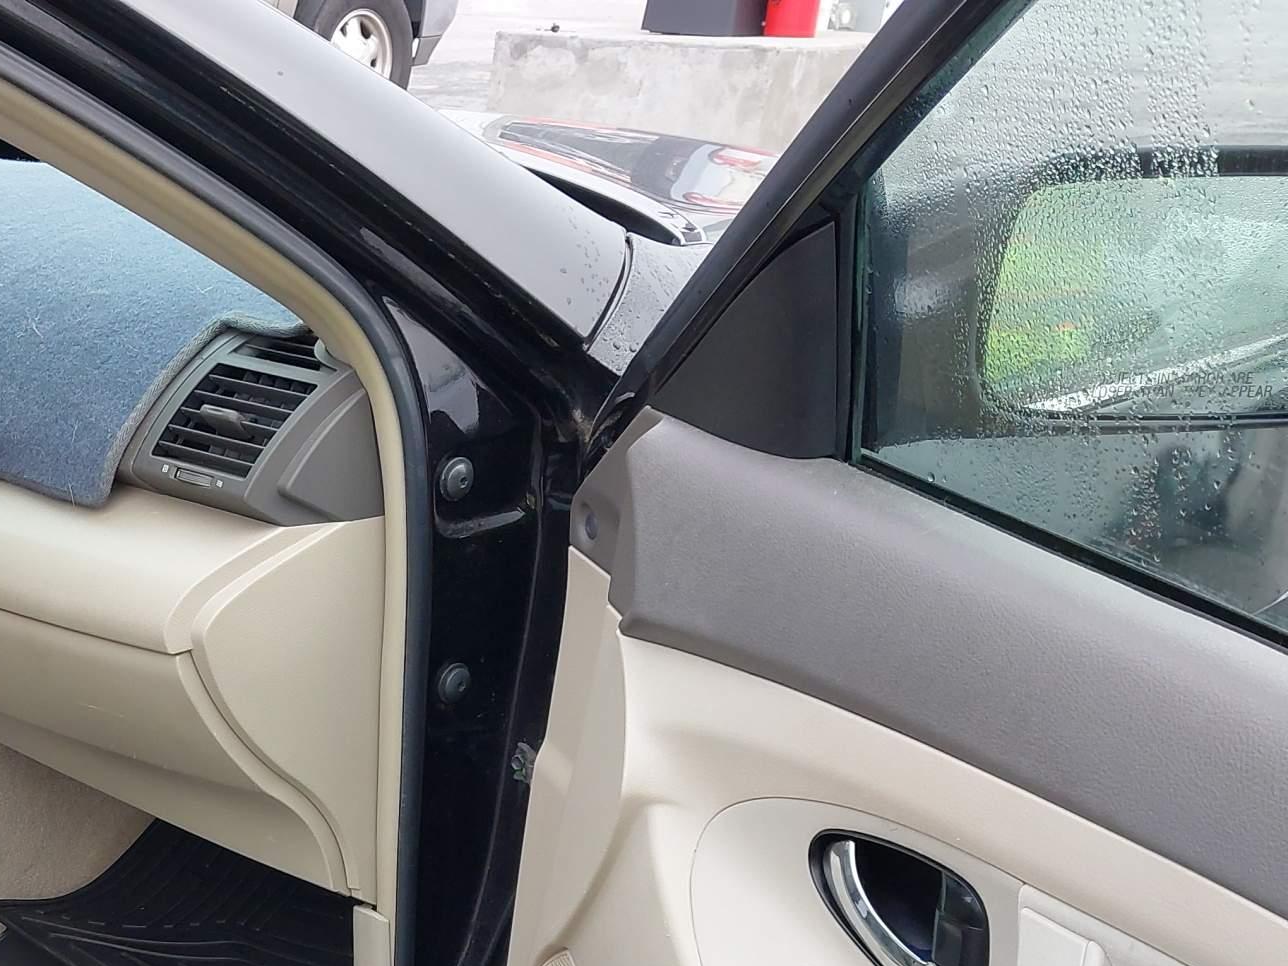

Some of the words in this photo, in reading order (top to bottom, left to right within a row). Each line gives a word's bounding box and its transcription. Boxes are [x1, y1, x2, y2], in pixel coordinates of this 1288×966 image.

[1175, 371, 1225, 385] RROR
[1229, 371, 1256, 385] ARE
[1085, 385, 1133, 398] LOSER
[1219, 385, 1273, 398] APPEAR
